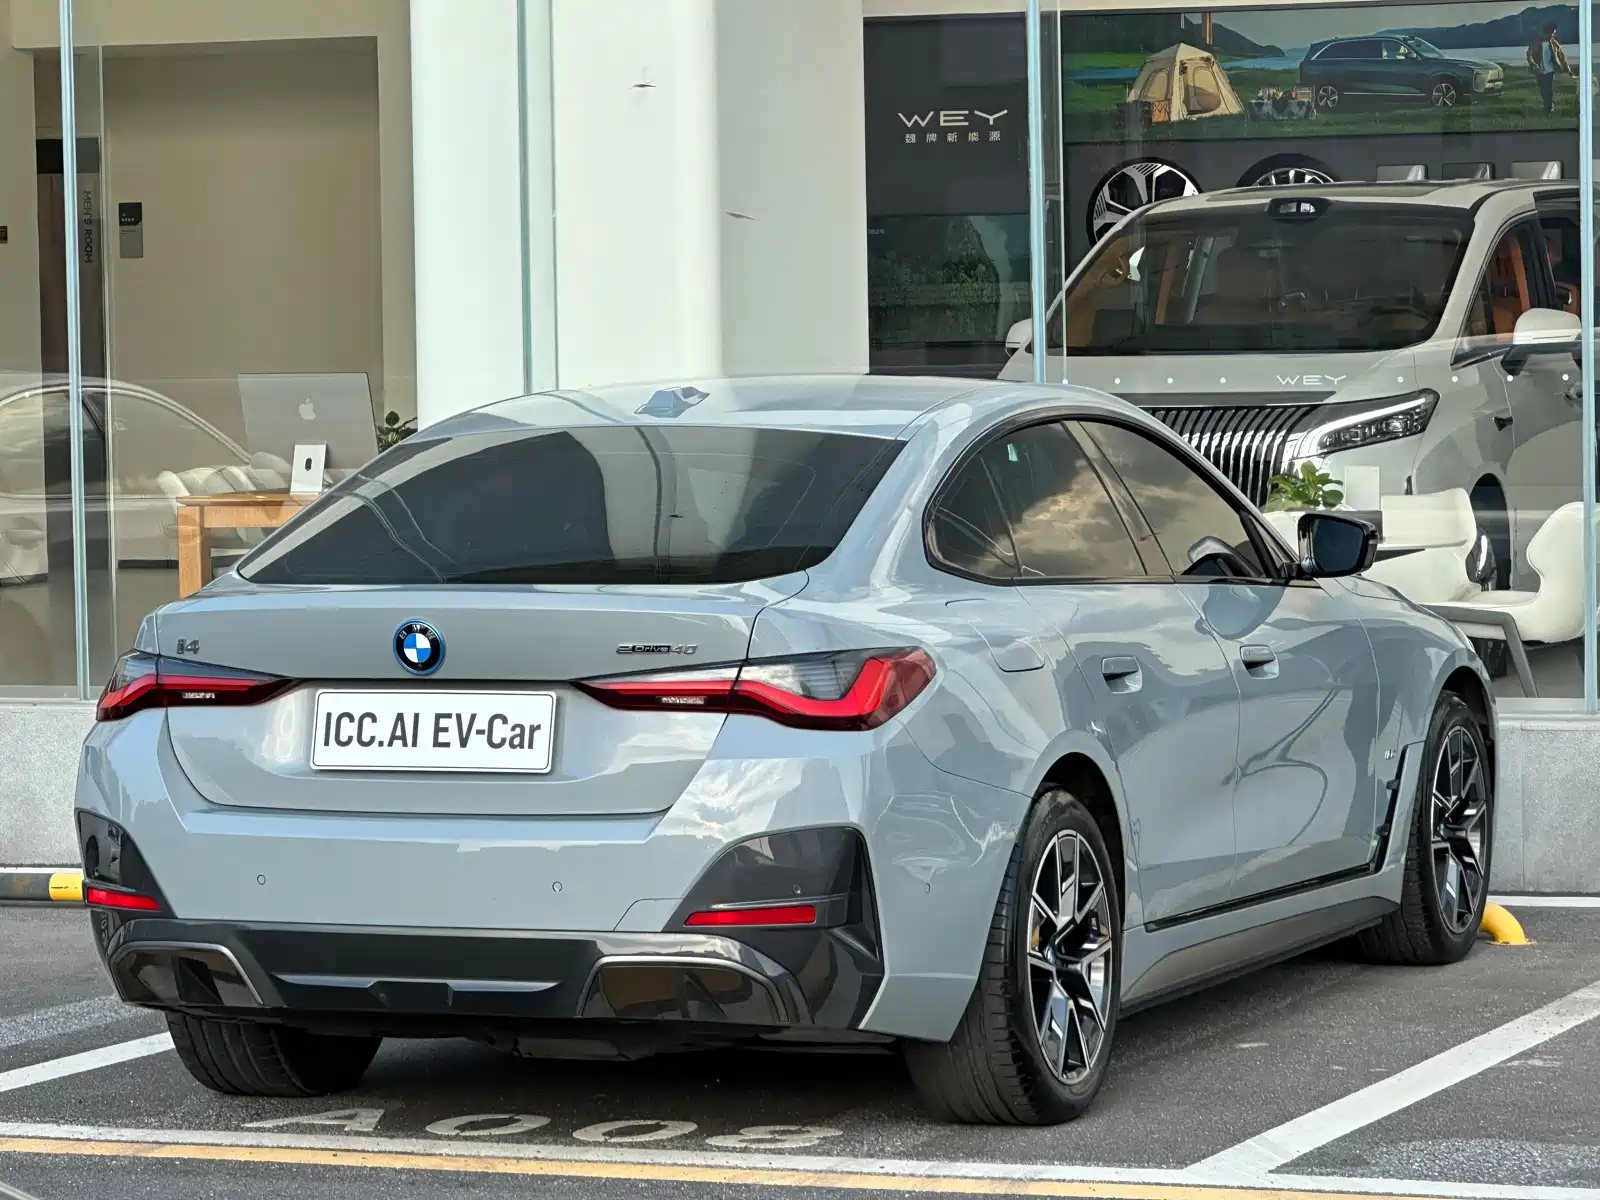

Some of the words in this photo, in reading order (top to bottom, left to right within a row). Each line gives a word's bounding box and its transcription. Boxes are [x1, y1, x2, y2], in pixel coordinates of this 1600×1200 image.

[898, 109, 1008, 128] WEY
[84, 228, 94, 264] ROOM
[1276, 374, 1347, 386] WEY
[399, 624, 436, 640] BMW
[177, 638, 200, 655] i4
[323, 711, 420, 748] ICC.AI
[432, 712, 542, 750] EV-Car
[240, 1107, 844, 1149] A008
